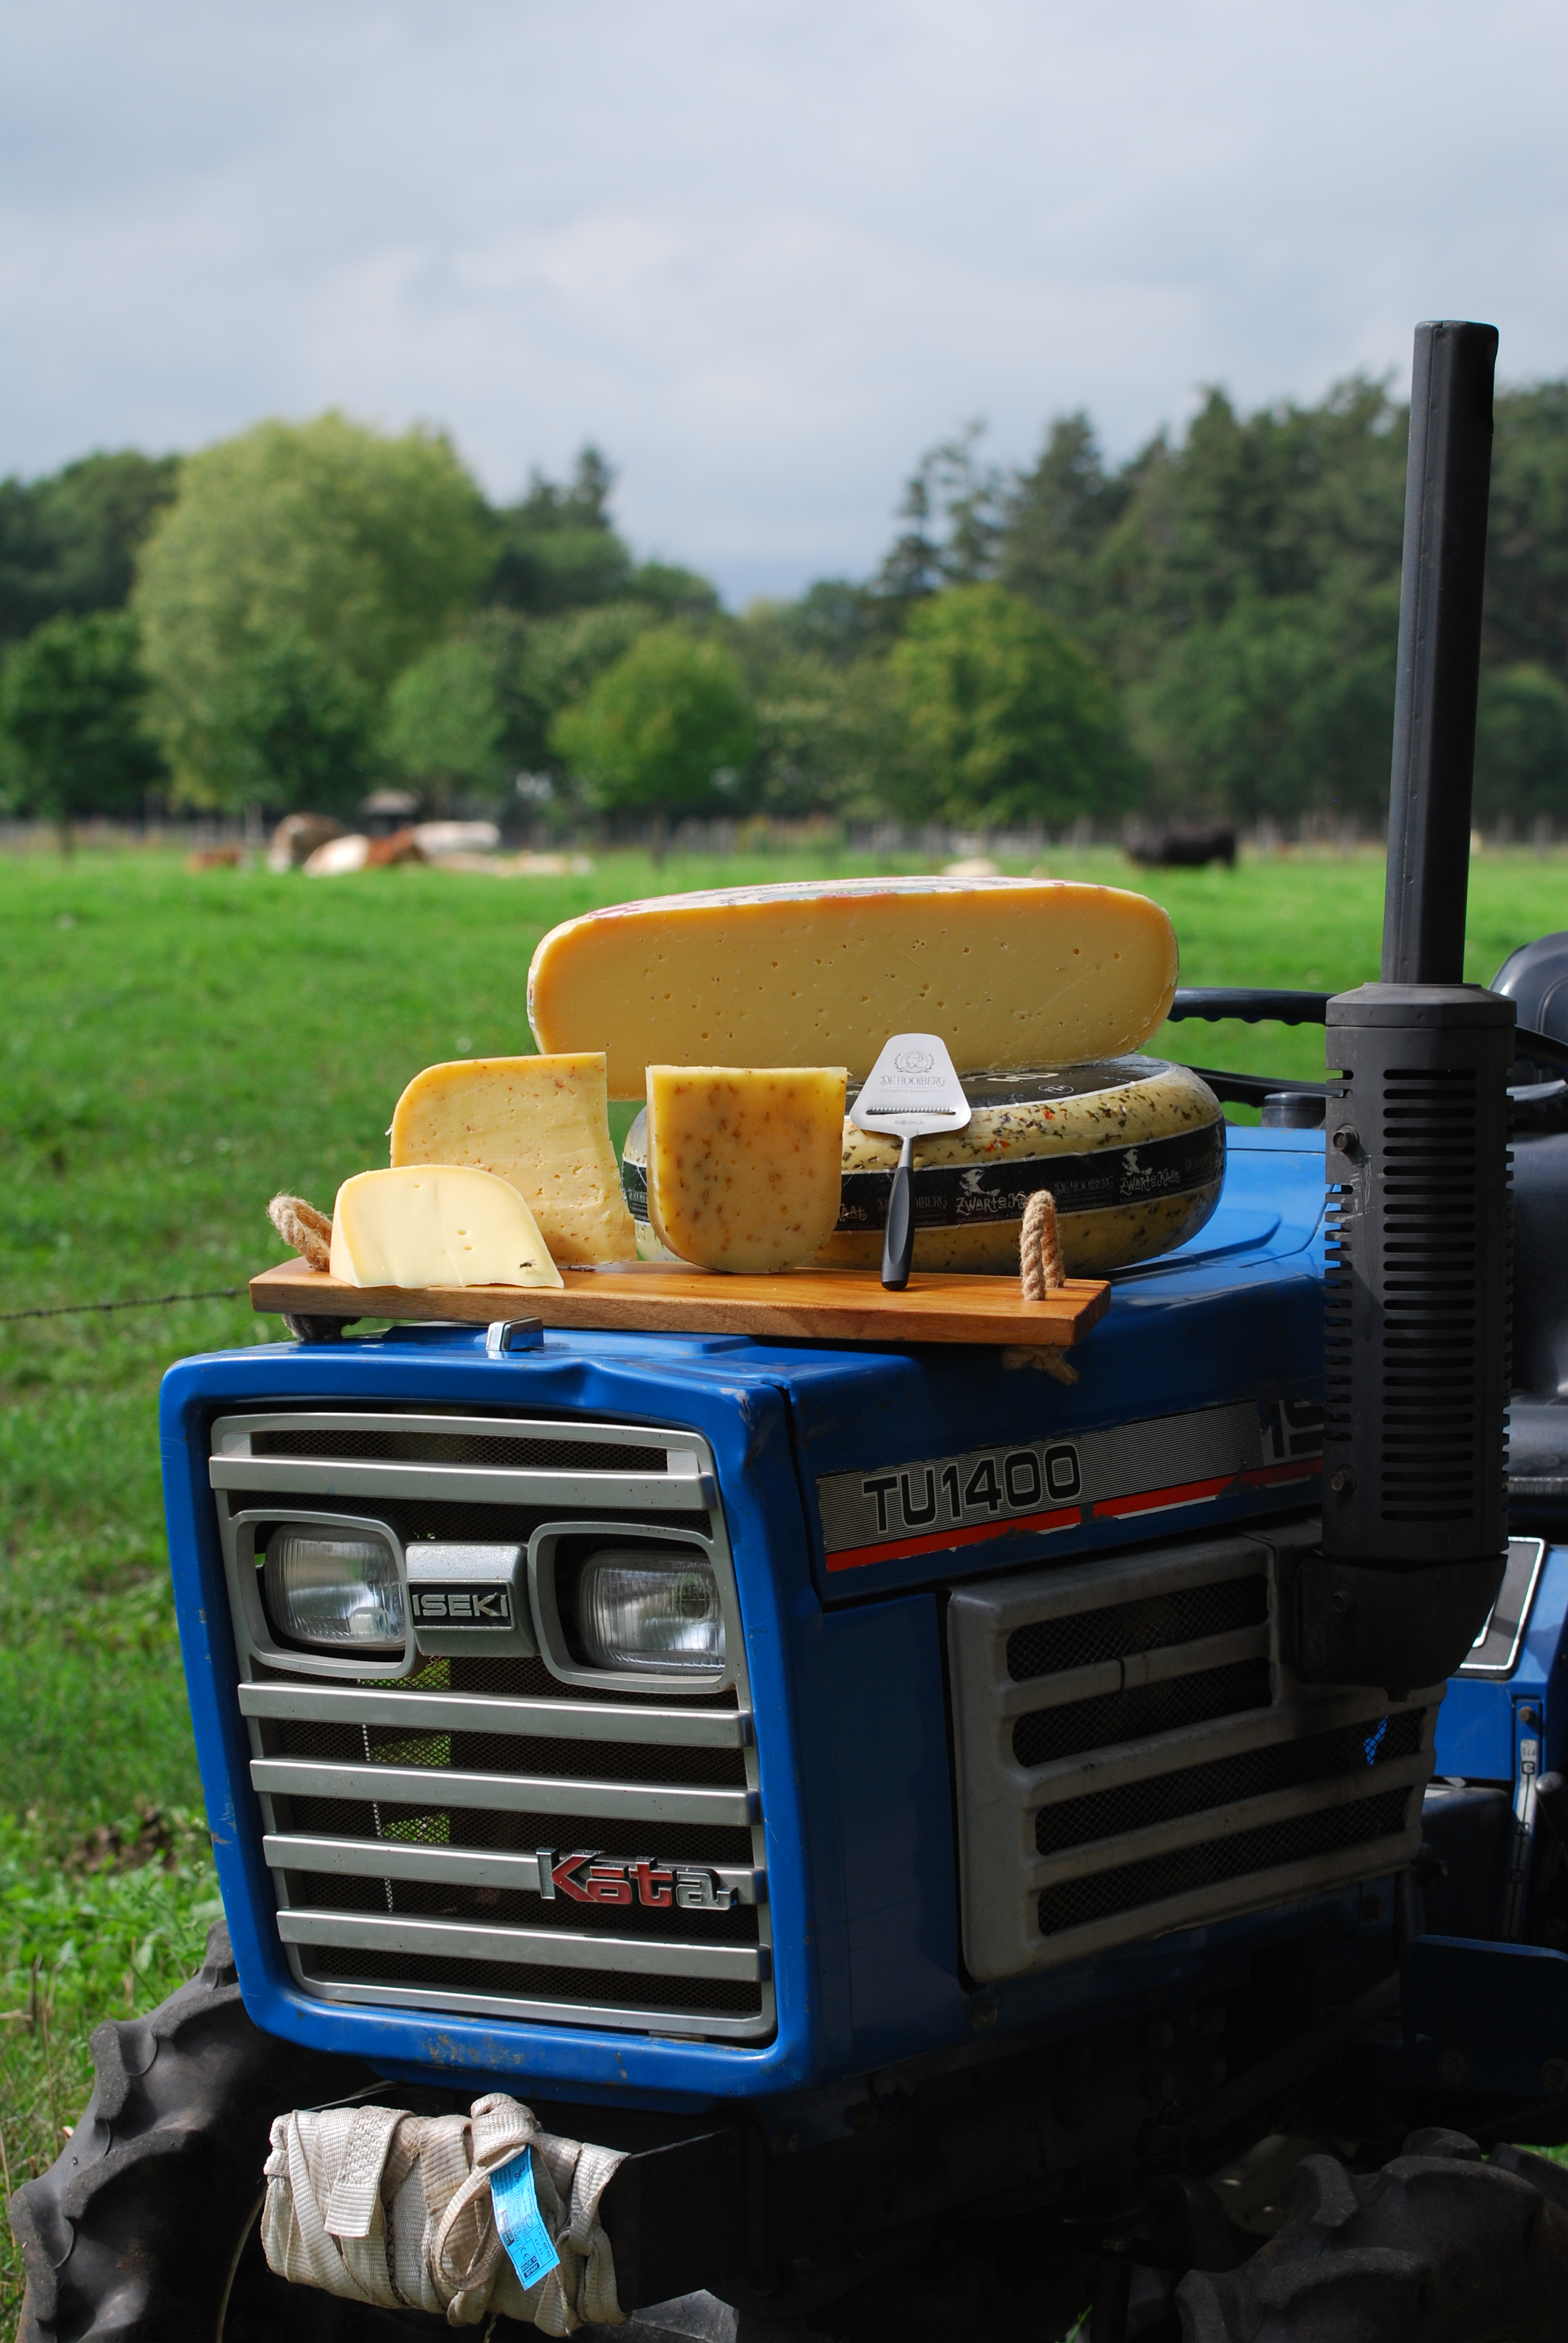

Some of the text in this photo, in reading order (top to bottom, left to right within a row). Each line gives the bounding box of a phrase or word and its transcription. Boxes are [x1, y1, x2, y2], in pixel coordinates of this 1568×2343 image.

[880, 1075, 896, 1086] DE
[897, 1076, 946, 1088] HOOIBERG
[915, 1194, 947, 1210] IBERG
[861, 1442, 1081, 1535] TU1400
[412, 1593, 509, 1617] ISEKI
[537, 1847, 737, 1910] Kata
